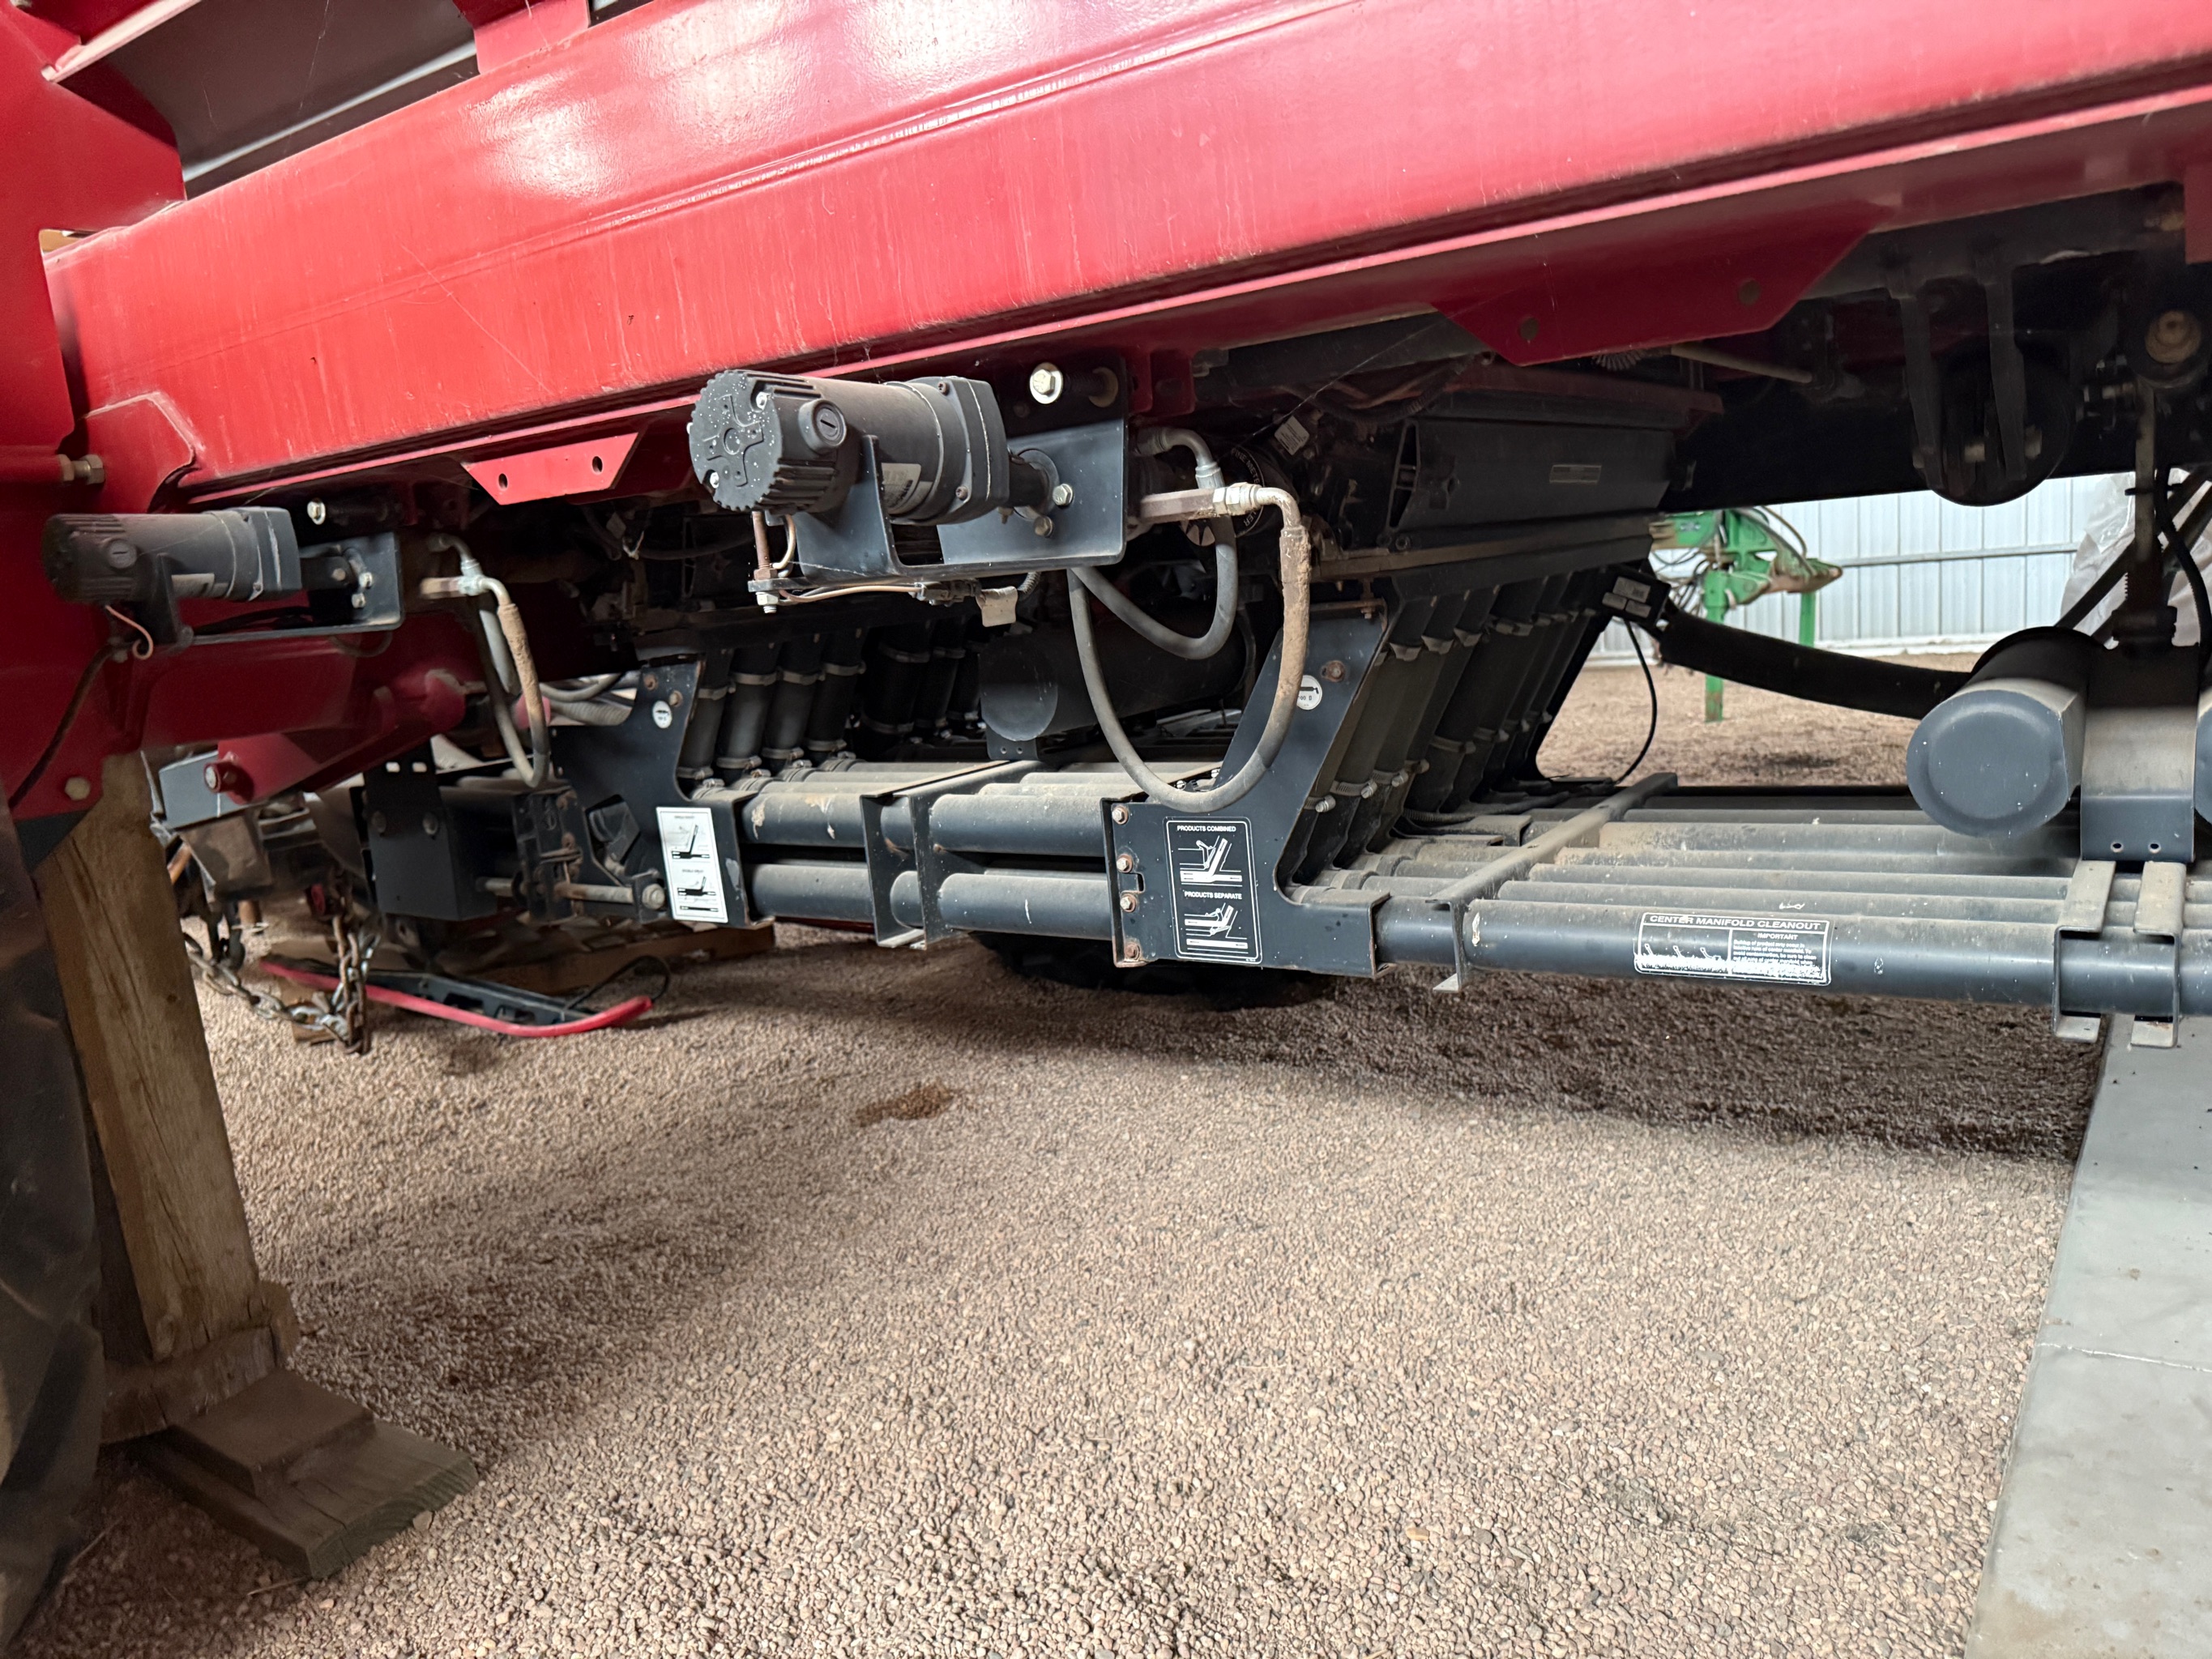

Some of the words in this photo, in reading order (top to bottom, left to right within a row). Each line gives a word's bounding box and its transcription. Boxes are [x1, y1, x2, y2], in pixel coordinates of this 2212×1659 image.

[1214, 892, 1243, 900] SEPARATE
[1650, 915, 1693, 924] CENTER
[1695, 917, 1755, 928] MANIFOLD
[1757, 919, 1821, 930] CLEANOUT
[1757, 932, 1799, 940] IMPORTANT
